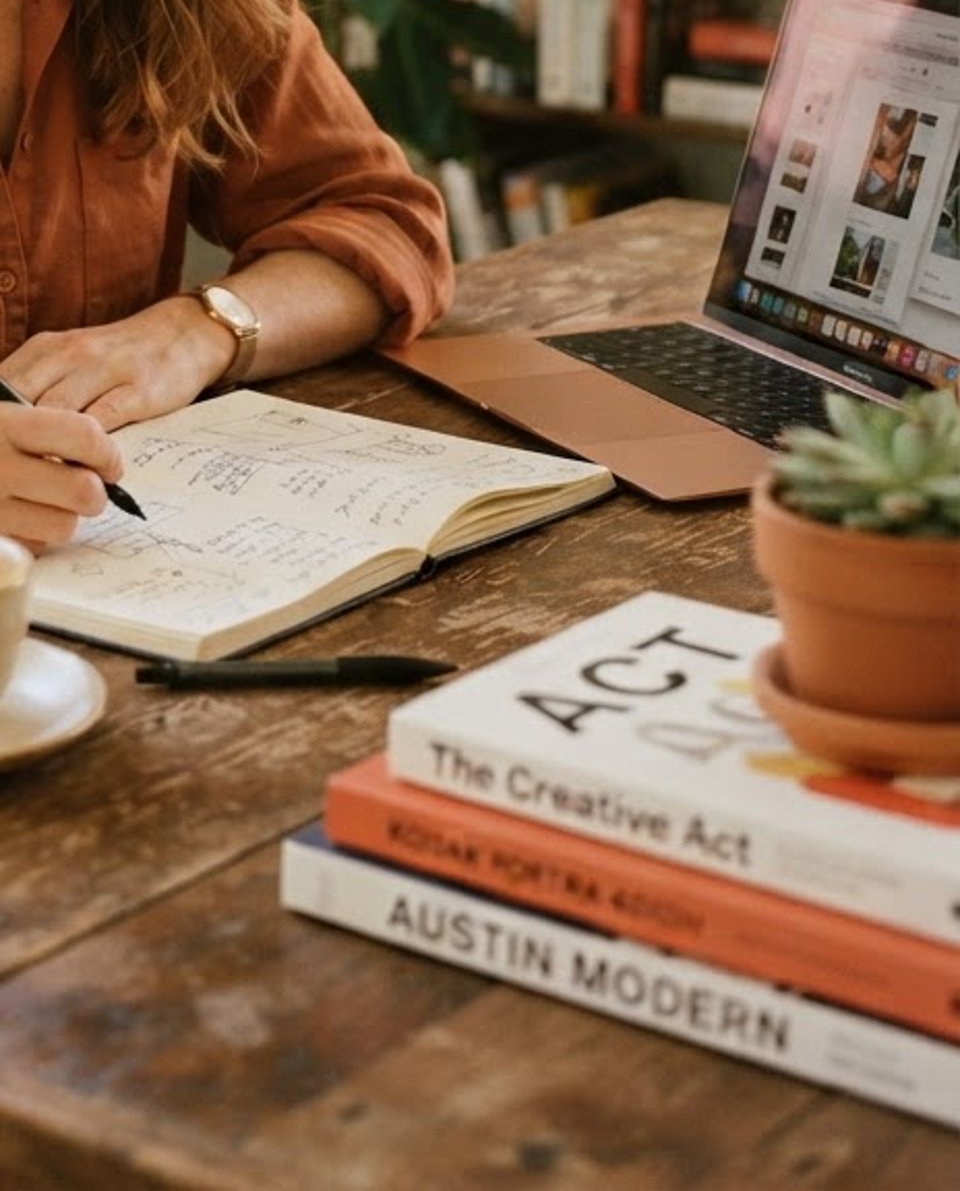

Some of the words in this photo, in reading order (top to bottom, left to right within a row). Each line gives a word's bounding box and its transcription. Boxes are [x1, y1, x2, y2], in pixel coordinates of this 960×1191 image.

[517, 625, 739, 734] ACT
[430, 742, 494, 790] The
[506, 763, 669, 840] Creative
[682, 815, 752, 866] Act
[386, 896, 554, 977] AUSTIN
[571, 950, 791, 1051] MODERN
